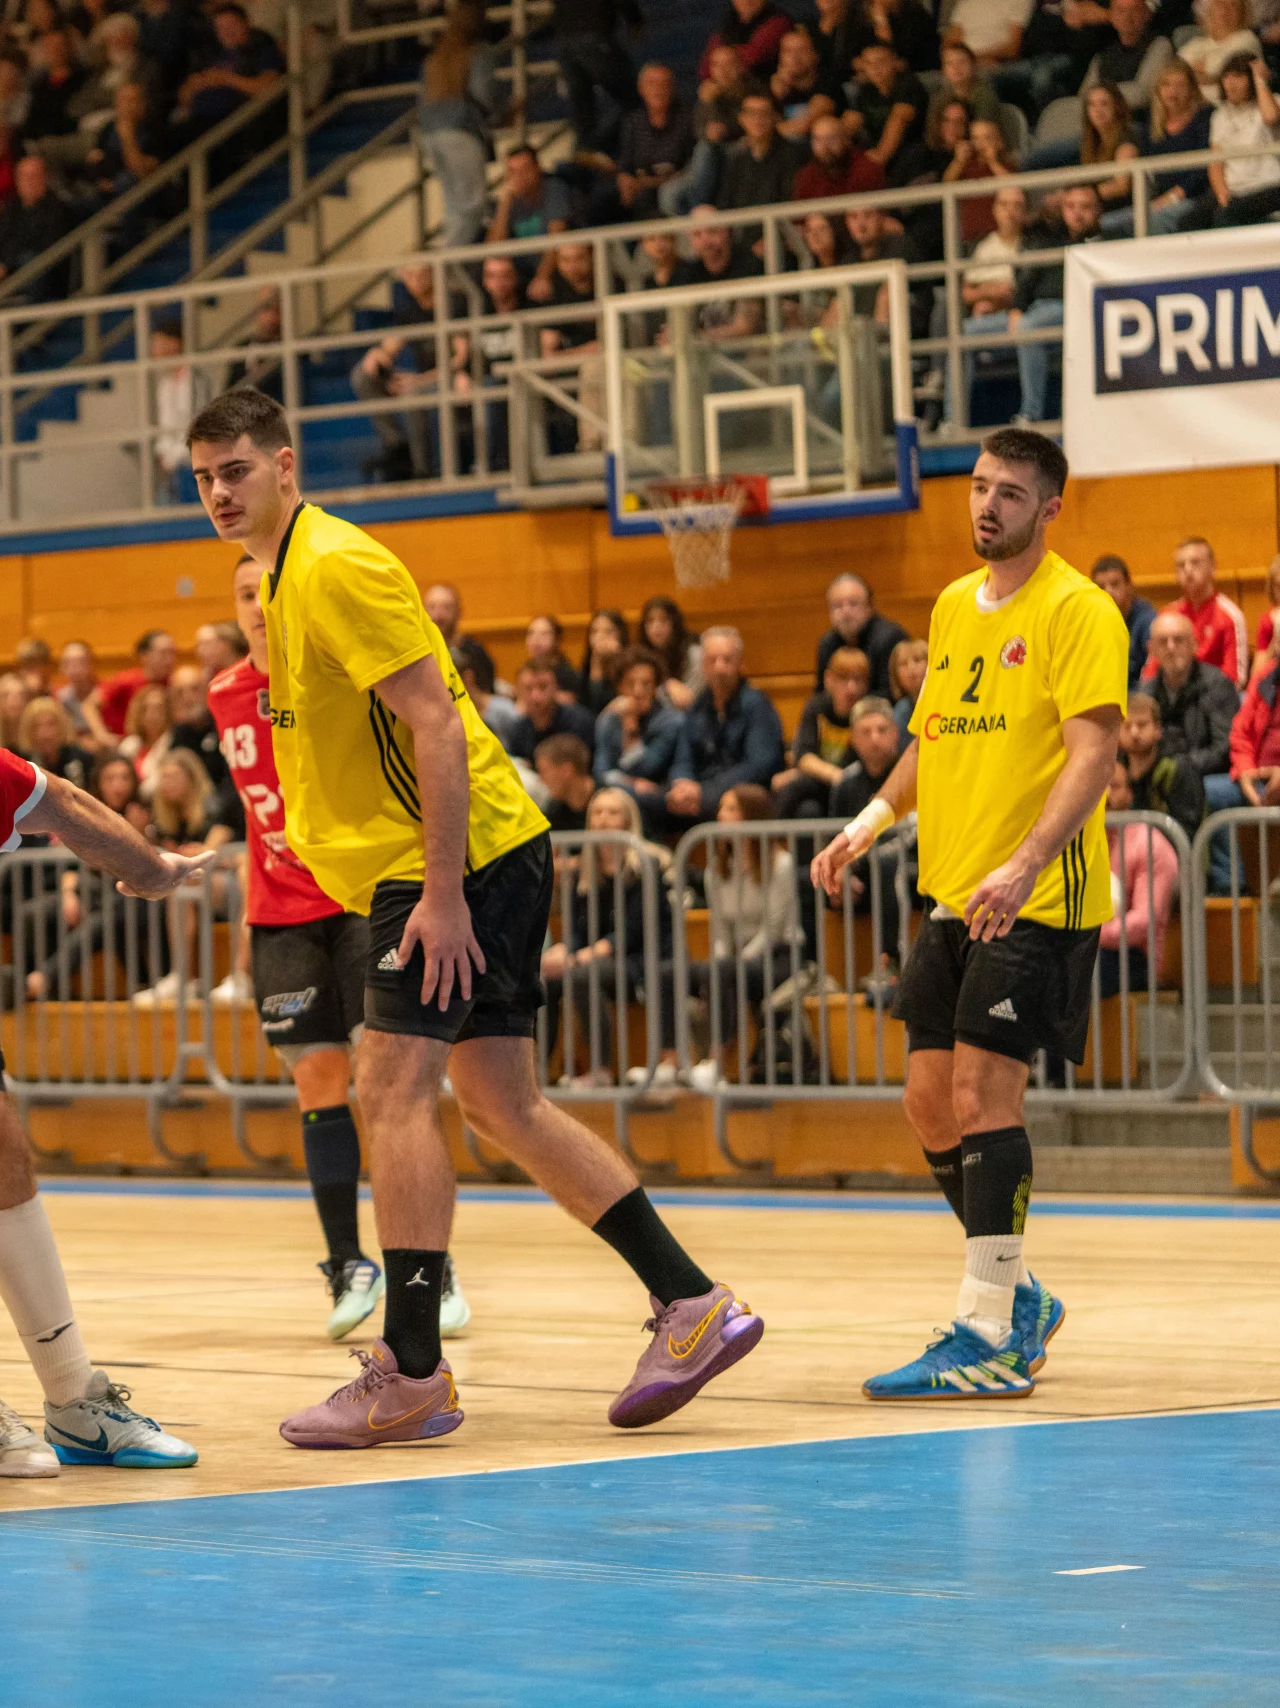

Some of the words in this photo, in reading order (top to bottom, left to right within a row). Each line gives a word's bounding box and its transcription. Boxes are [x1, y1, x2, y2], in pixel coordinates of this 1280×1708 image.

[960, 655, 984, 703] 2
[220, 724, 257, 770] 13
[989, 1007, 1017, 1022] adidas
